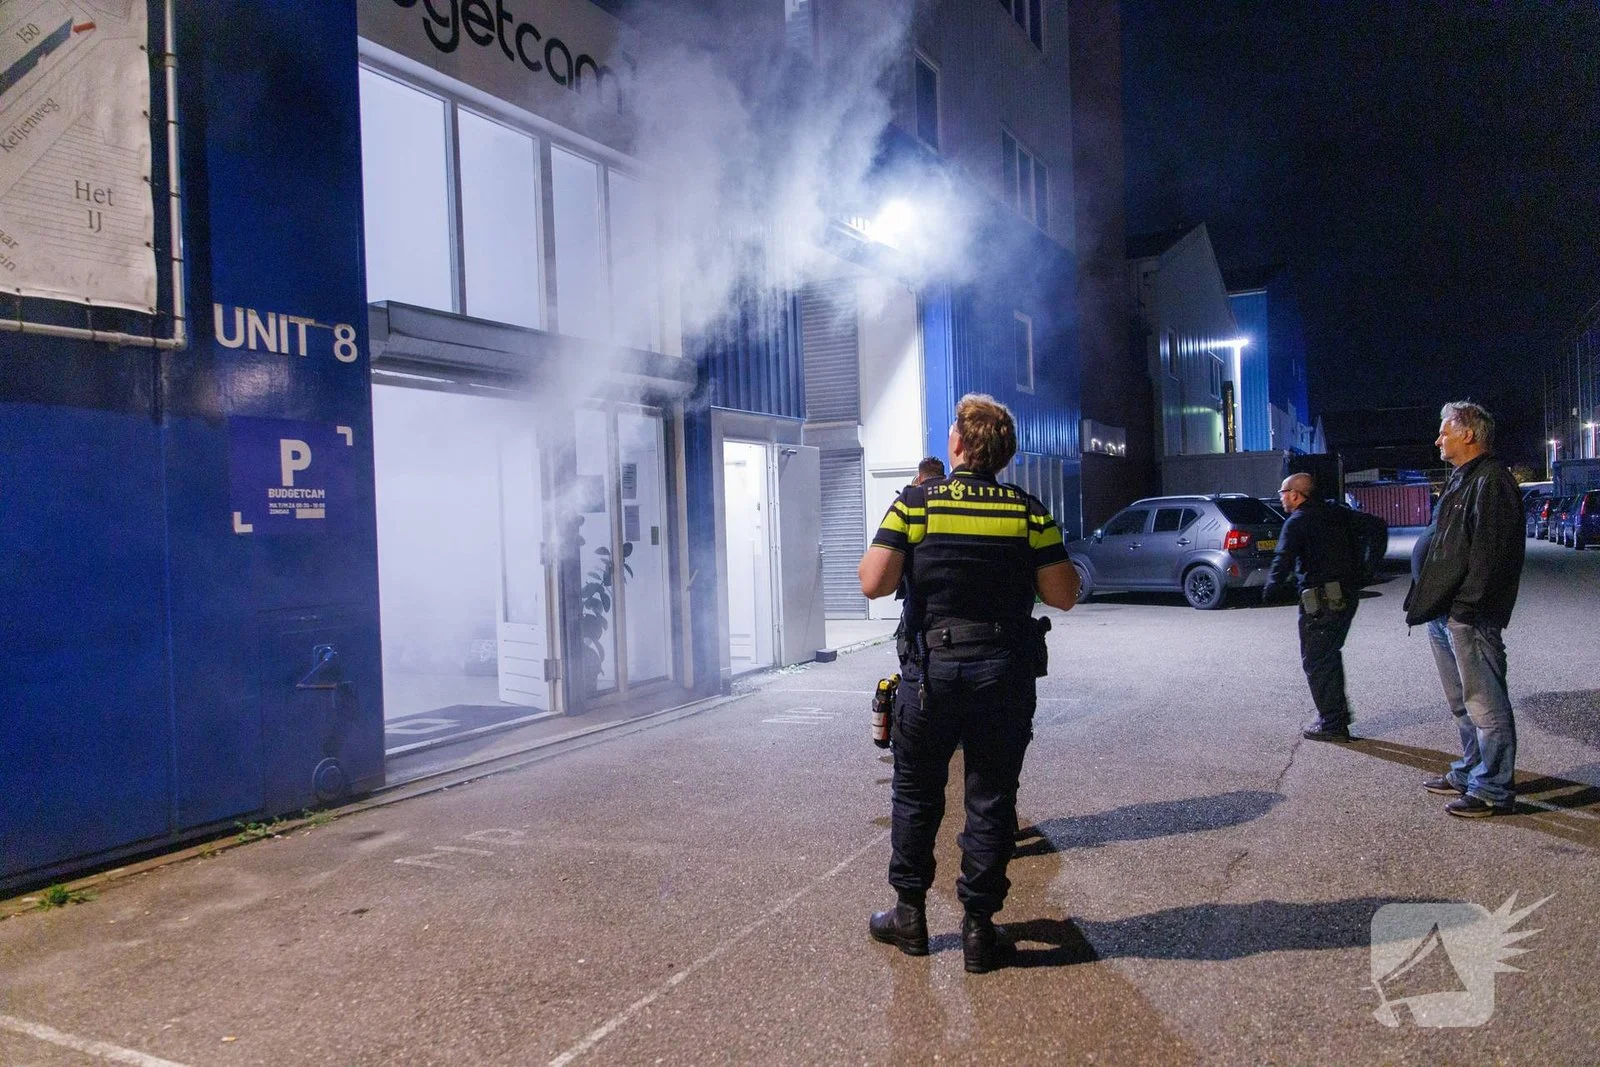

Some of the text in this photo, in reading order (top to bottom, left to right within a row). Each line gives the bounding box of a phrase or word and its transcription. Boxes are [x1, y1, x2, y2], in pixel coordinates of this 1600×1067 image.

[15, 23, 41, 44] 150
[74, 179, 114, 206] Het
[87, 209, 102, 233] IJ
[213, 303, 359, 363] UNIT 8
[279, 438, 313, 487] P
[268, 488, 326, 499] BUDGETCAM
[938, 480, 1016, 500] POLITIE
